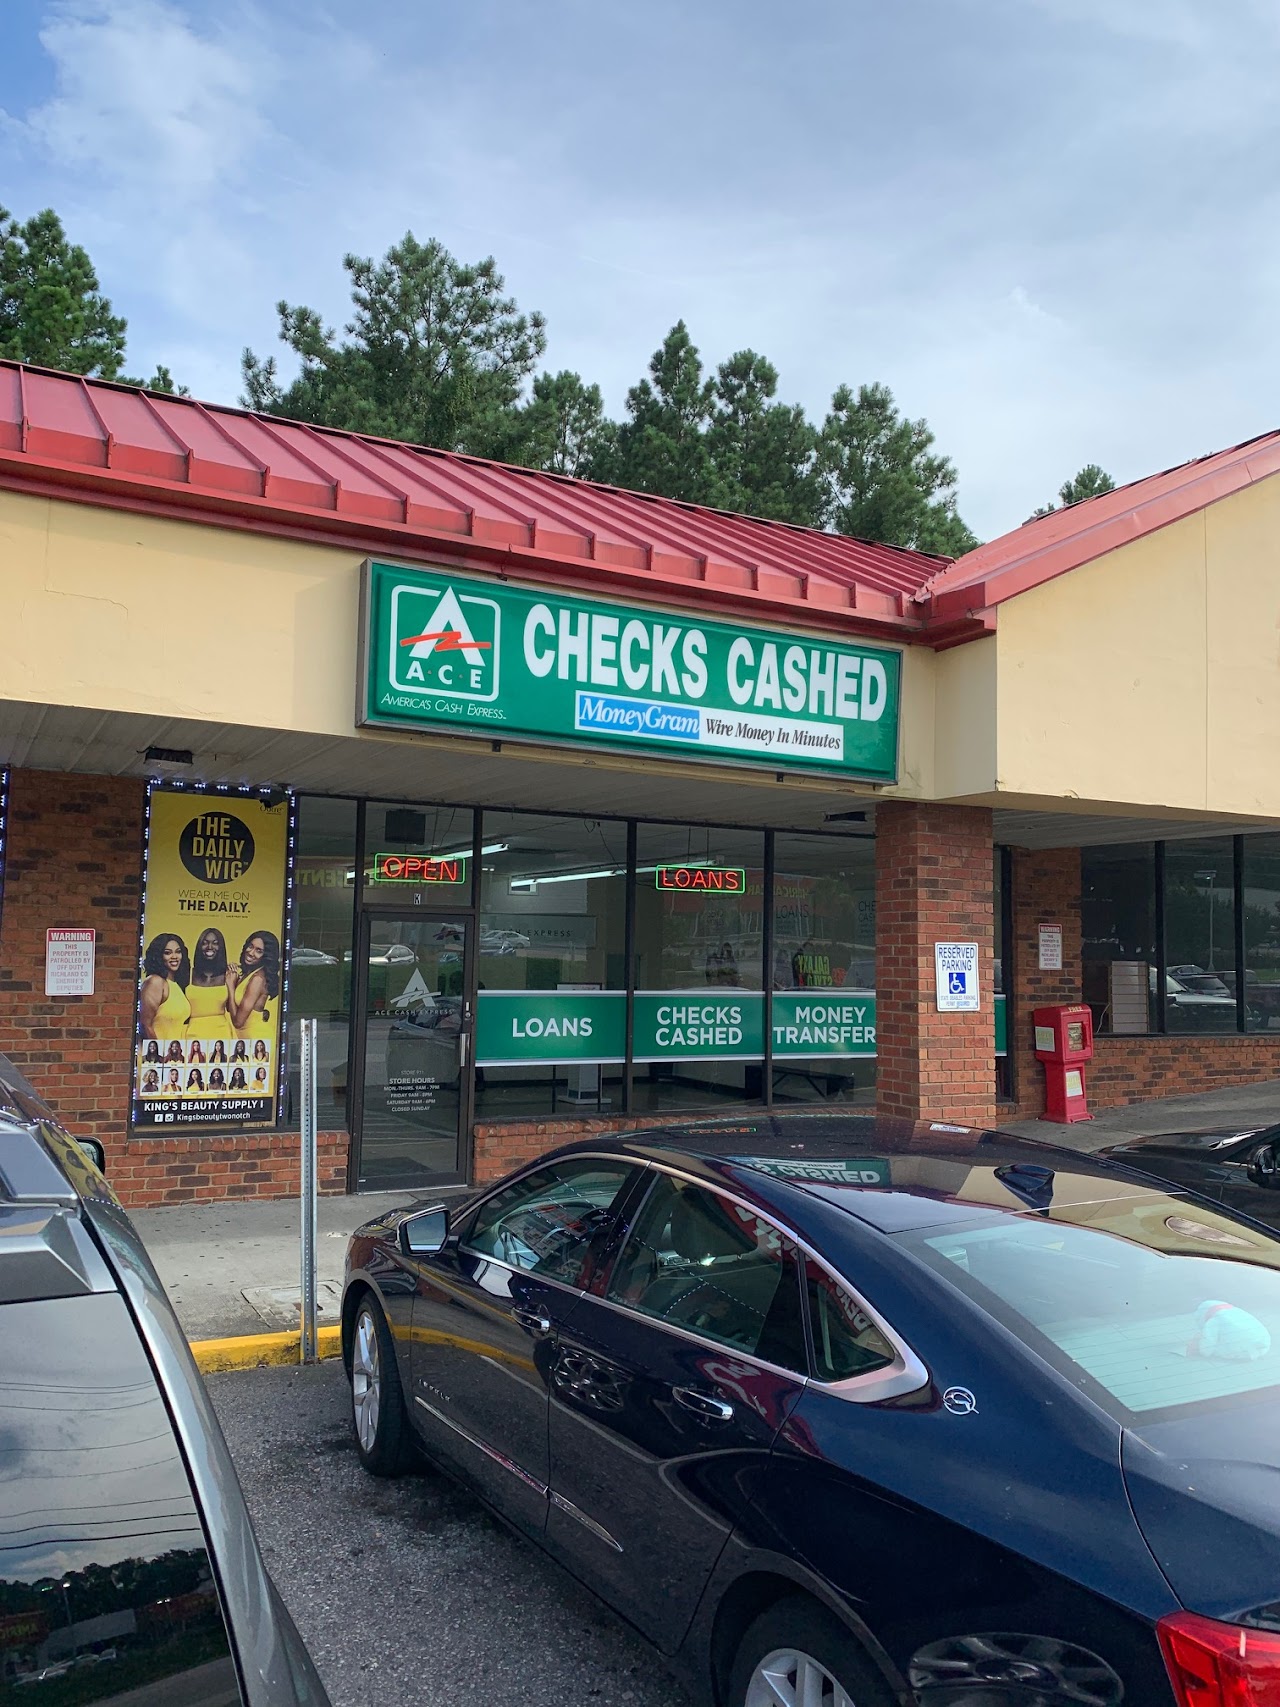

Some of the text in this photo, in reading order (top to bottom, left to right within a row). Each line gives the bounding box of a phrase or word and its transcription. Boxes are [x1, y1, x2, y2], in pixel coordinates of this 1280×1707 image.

[523, 603, 887, 722] CHECKS CASHED
[381, 692, 431, 710] AMERICA'S
[435, 699, 463, 714] CASH
[579, 697, 841, 750] MoneyGram Wire Money In Minutes
[195, 815, 231, 837] THE
[192, 836, 245, 859] DAILY
[205, 859, 242, 881] WIG
[383, 856, 457, 881] OPEN
[662, 868, 739, 890] LOANS
[178, 889, 250, 901] WEAR ME ON
[178, 899, 251, 913] THE DAILY.
[51, 932, 92, 941] WARNING
[938, 947, 975, 959] RESERVED
[941, 959, 972, 971] PARKING
[656, 1006, 742, 1026] CHECKS
[795, 1006, 867, 1024] MONEY
[512, 1018, 593, 1038] LOANS
[655, 1027, 743, 1046] CASHED
[389, 1077, 411, 1085] STORE
[144, 1102, 178, 1112] KING'S
[181, 1101, 219, 1111] BEAUTY
[222, 1100, 258, 1110] SUPPLY
[177, 1112, 251, 1122] Kingsbeautytwonotch
